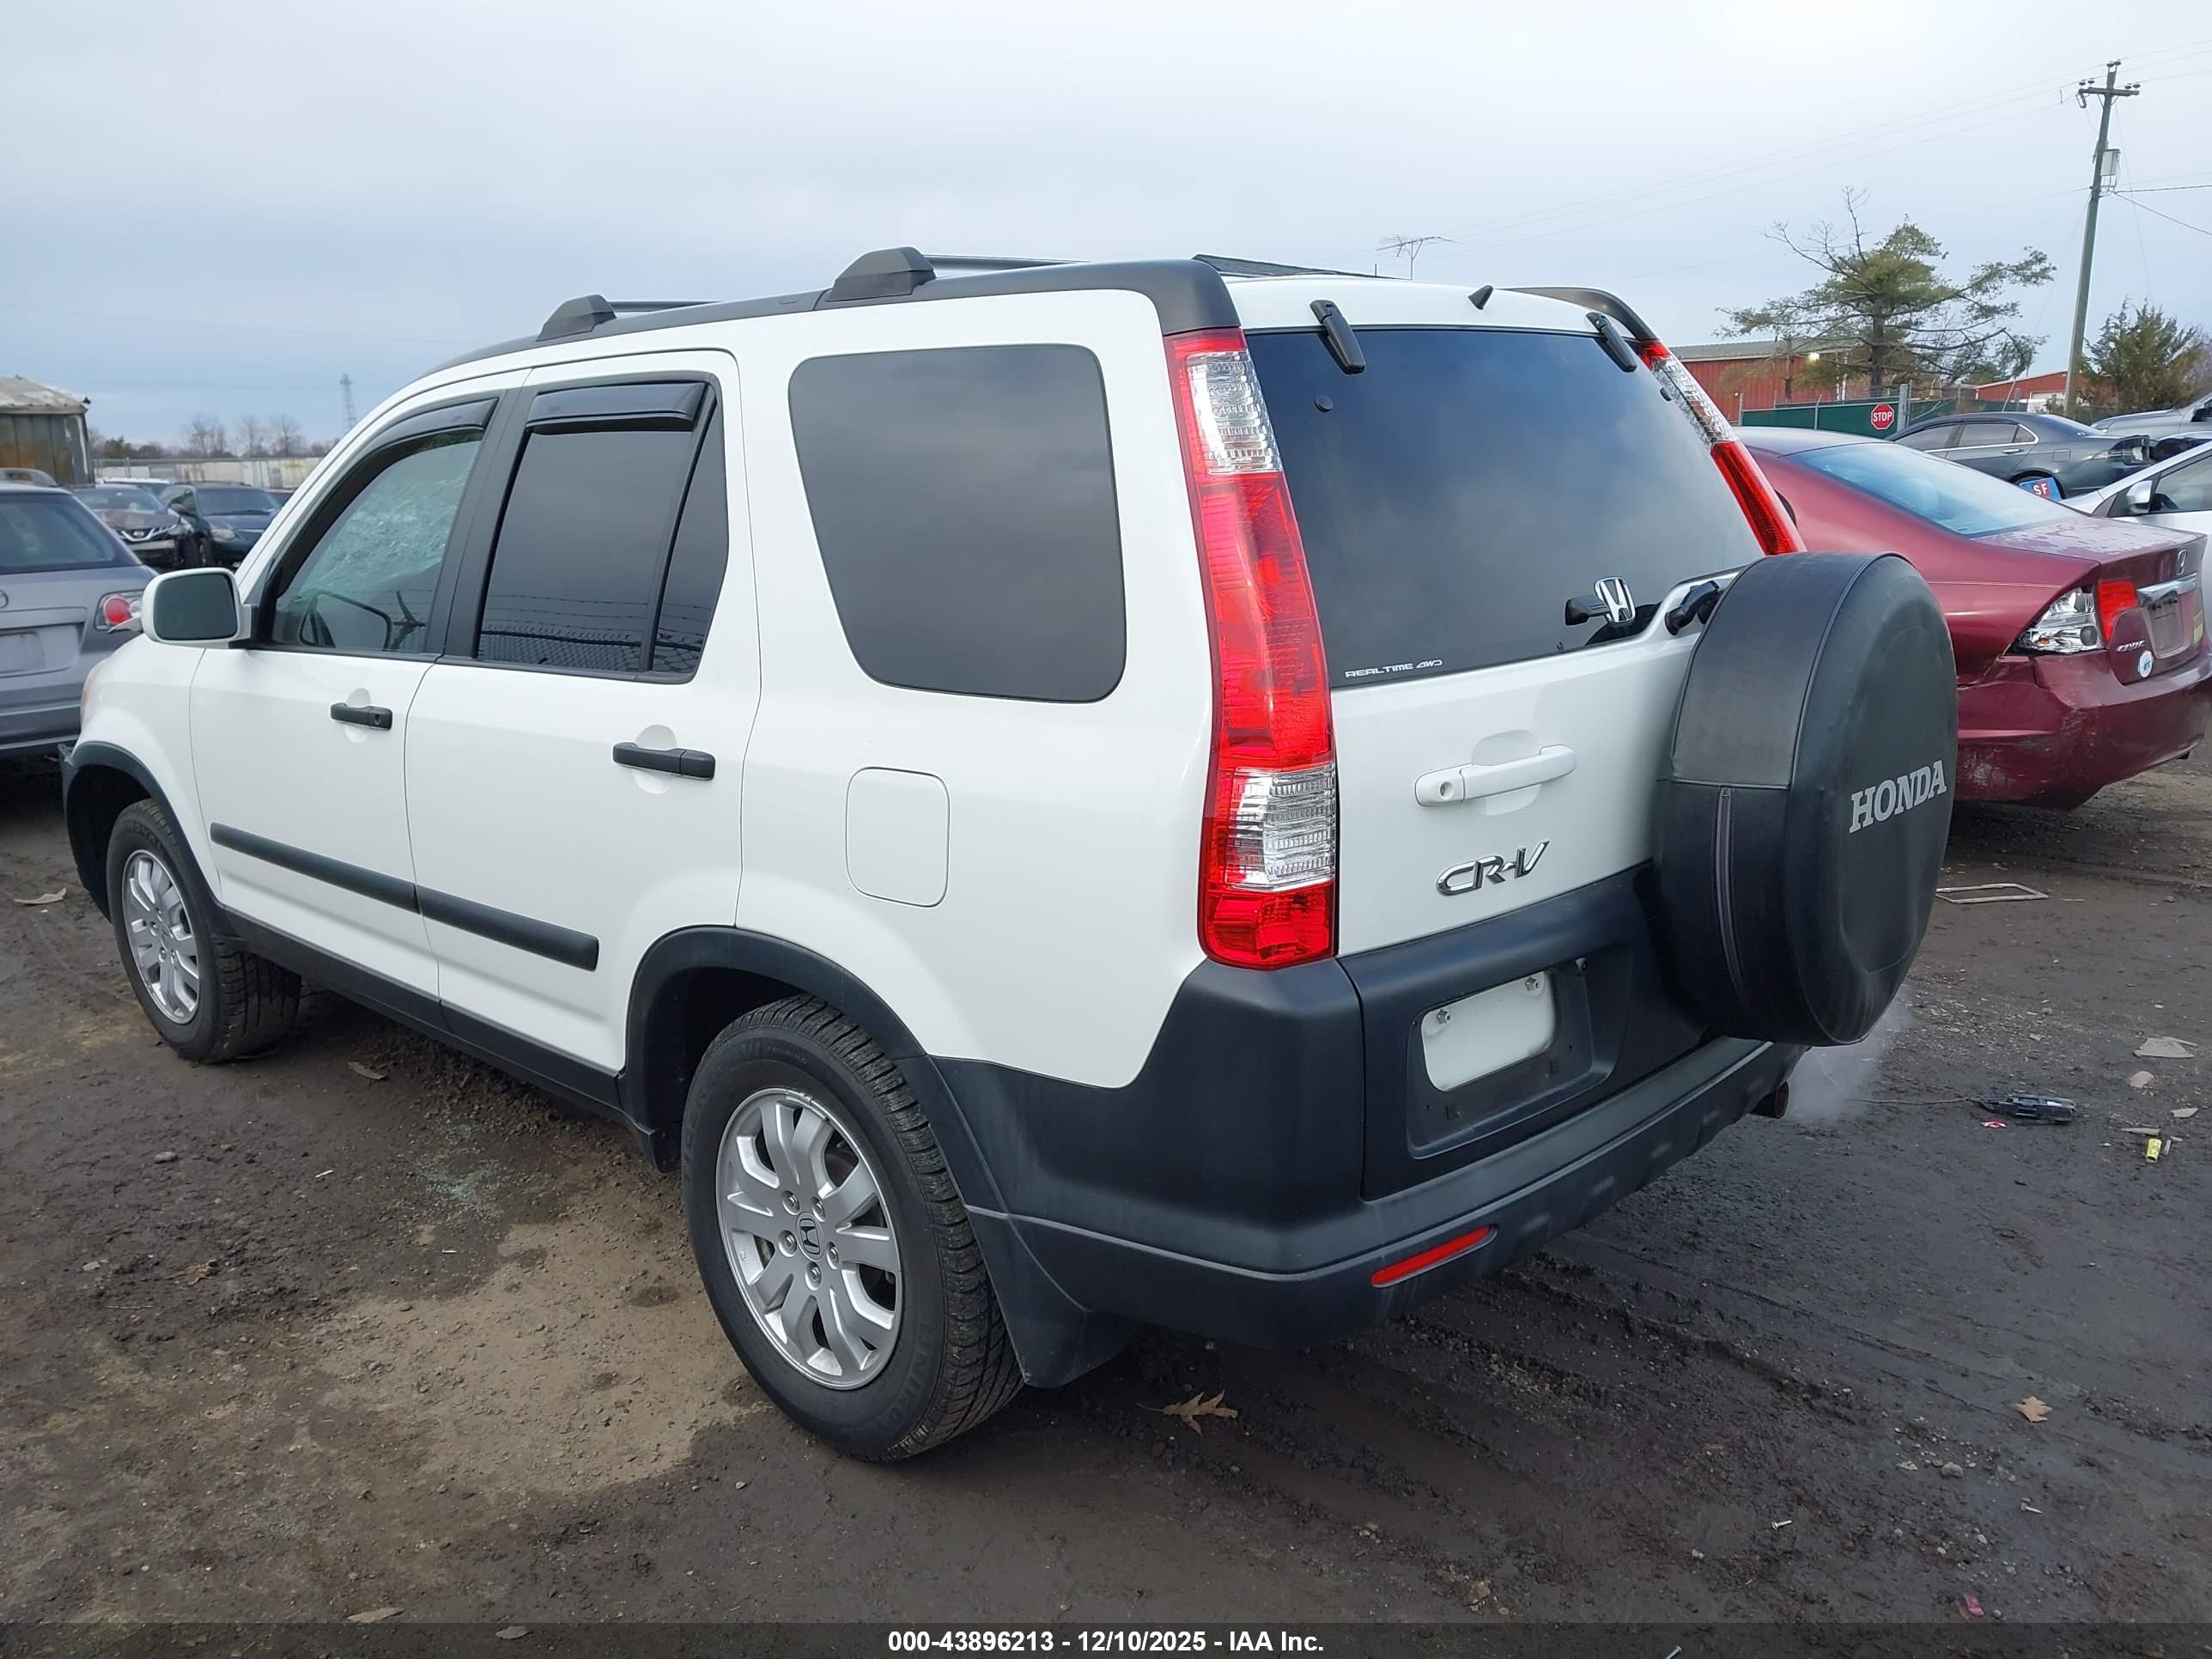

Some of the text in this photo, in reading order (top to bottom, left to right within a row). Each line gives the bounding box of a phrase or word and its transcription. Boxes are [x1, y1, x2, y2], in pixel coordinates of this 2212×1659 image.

[1873, 411, 1893, 422] STOP
[1416, 659, 1443, 669] 4WD
[1849, 760, 1948, 834] HONDA
[1437, 840, 1550, 896] CR-V
